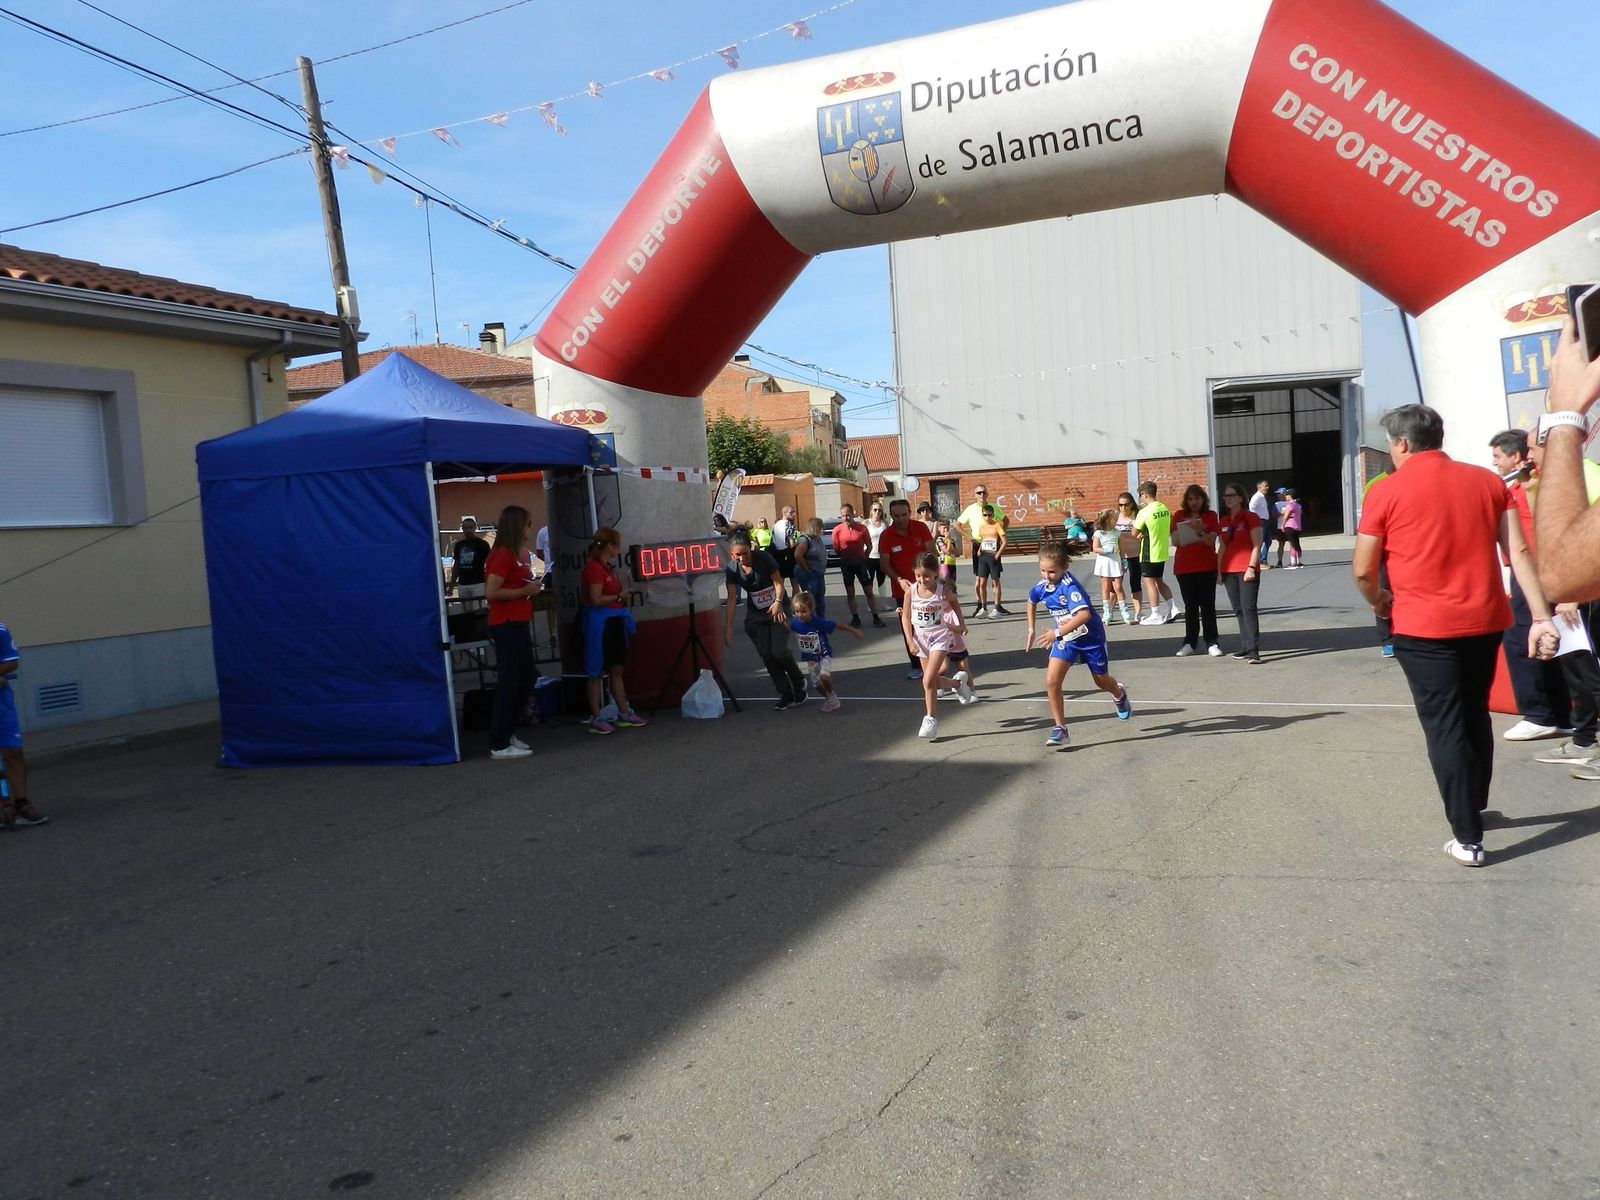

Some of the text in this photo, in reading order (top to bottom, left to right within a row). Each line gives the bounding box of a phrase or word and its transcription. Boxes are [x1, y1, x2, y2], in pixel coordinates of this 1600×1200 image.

[910, 48, 1098, 114] Diputación
[1288, 43, 1559, 218] CON NUESTROS
[918, 113, 1144, 179] de Salamanca
[1271, 89, 1507, 248] DEPORTISTAS
[559, 152, 723, 363] CON EL DEPORTE
[917, 611, 935, 621] 551
